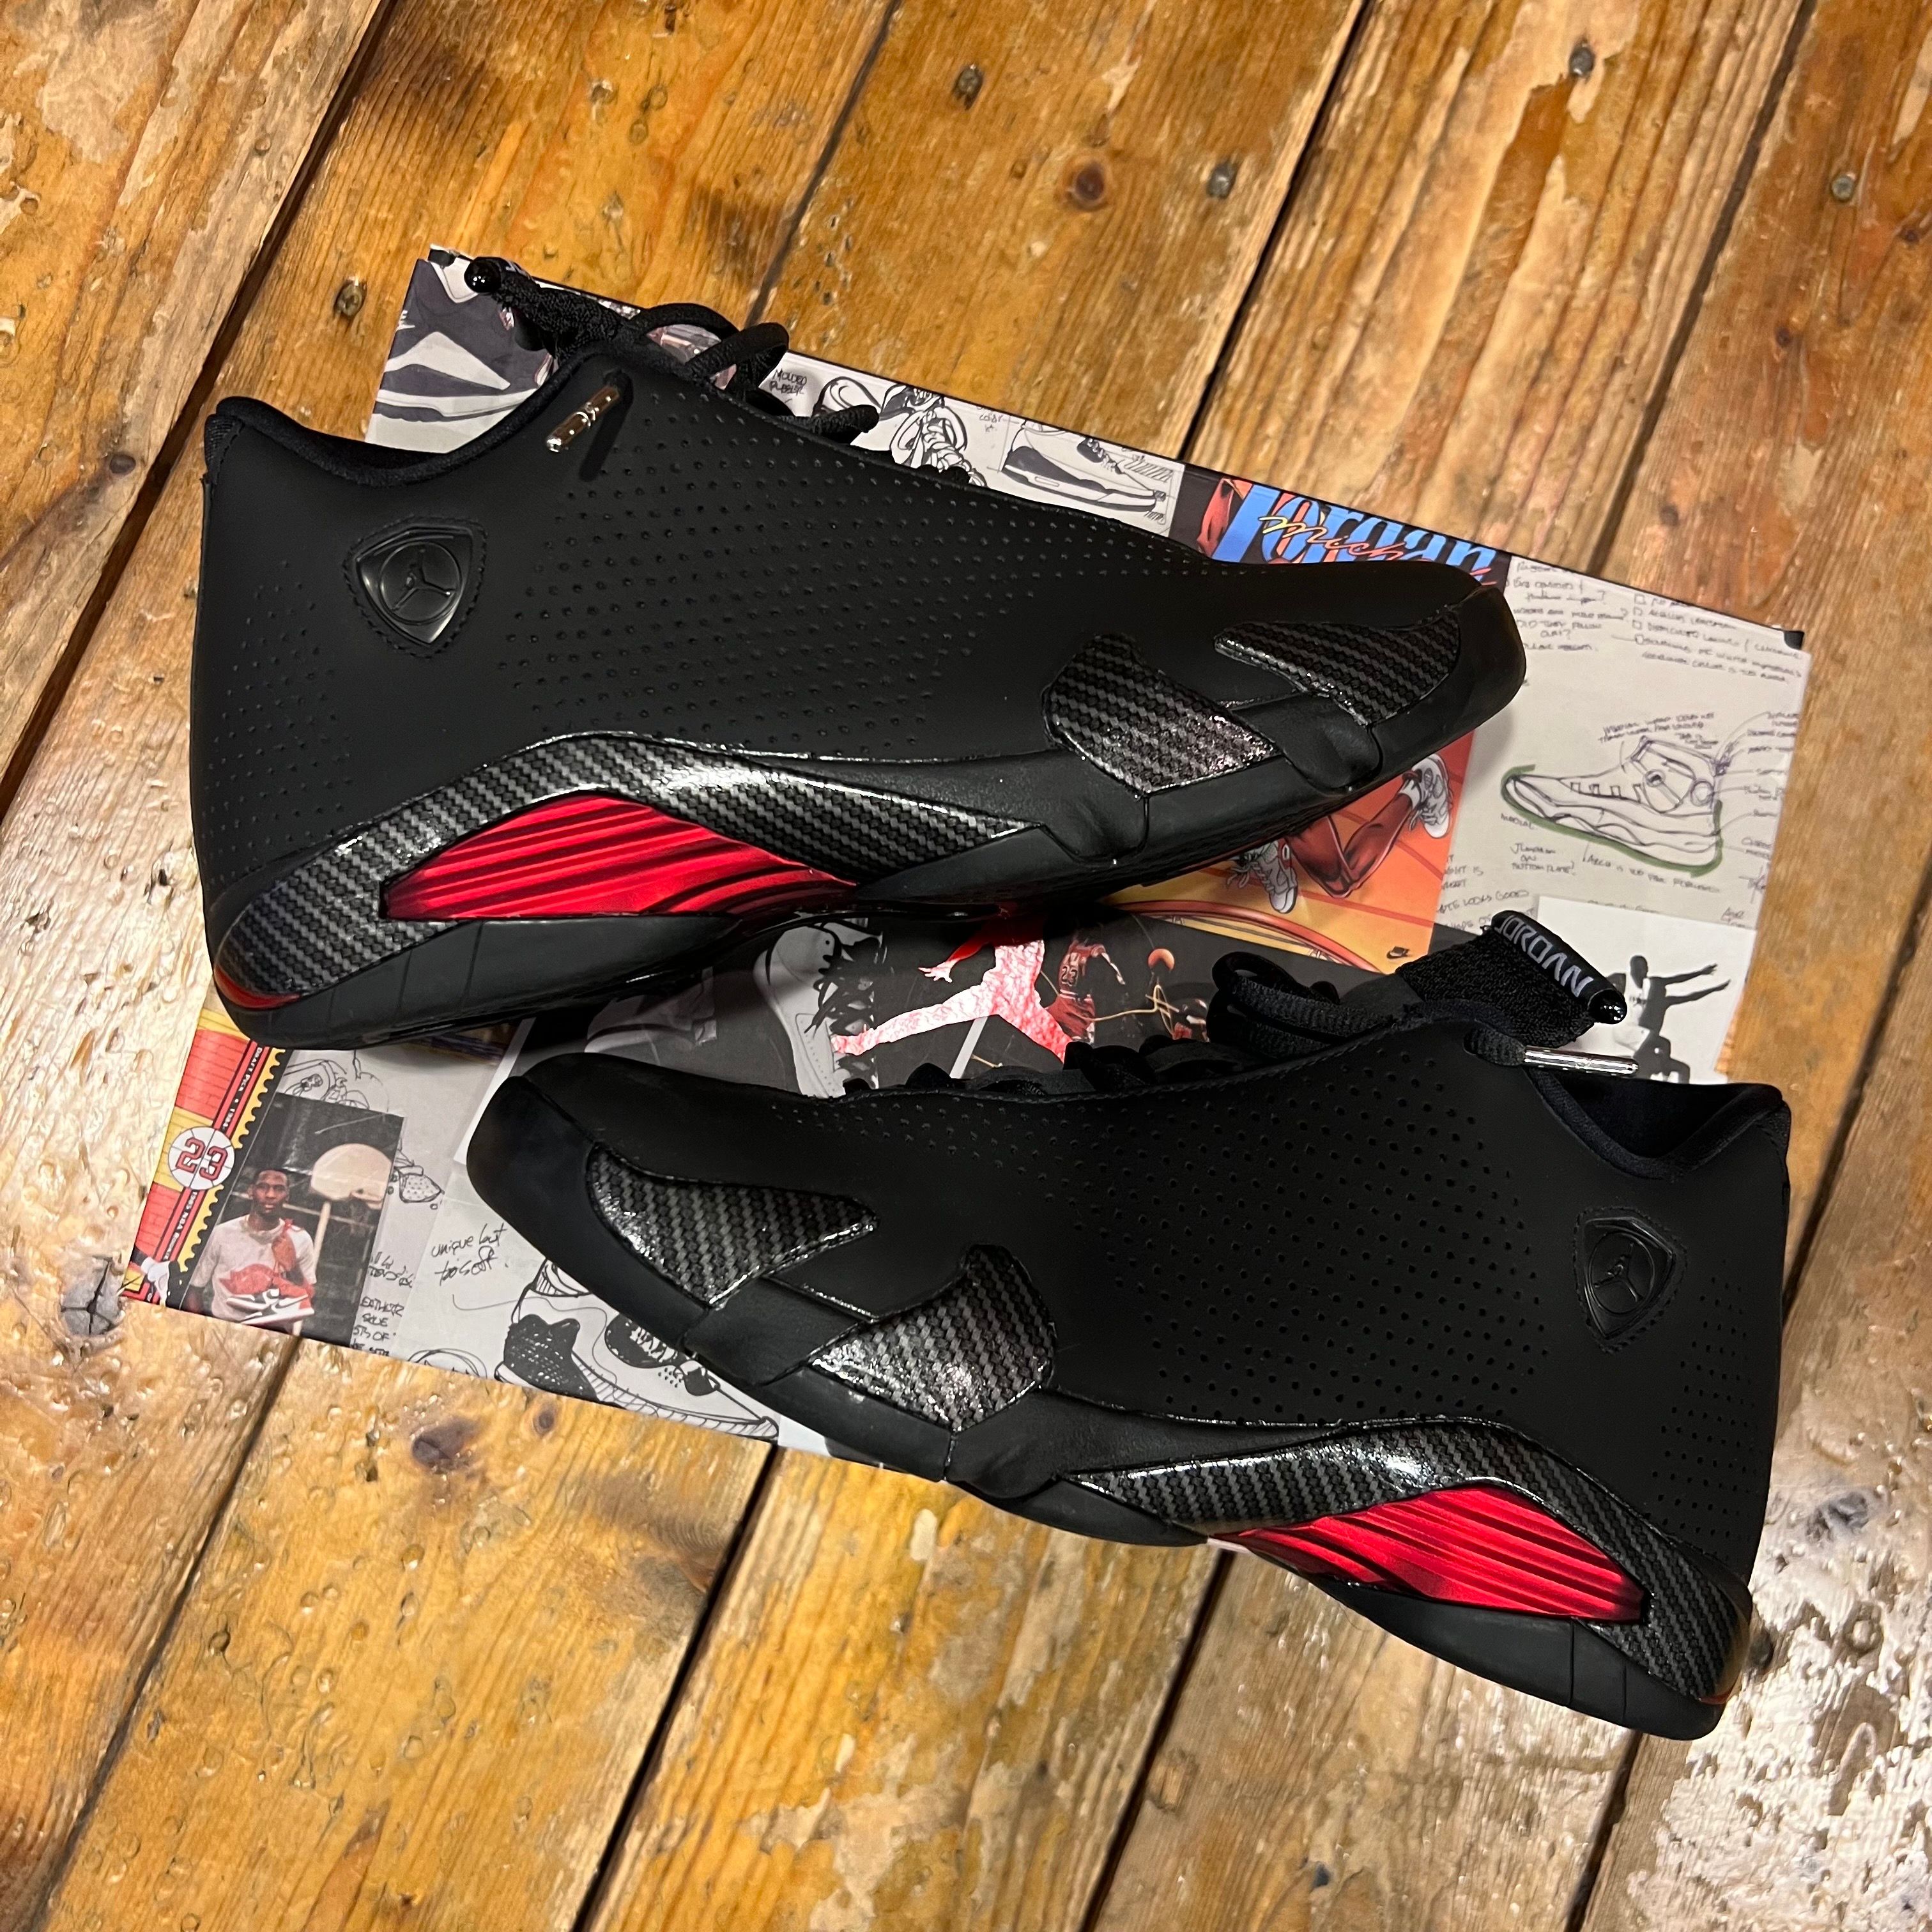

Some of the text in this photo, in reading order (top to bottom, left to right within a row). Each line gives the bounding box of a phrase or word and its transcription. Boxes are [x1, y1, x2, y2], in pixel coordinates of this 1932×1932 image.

[1494, 915, 1594, 997] JORDAN
[1061, 965, 1078, 986] 23
[175, 1137, 228, 1181] 23
[177, 1211, 188, 1230] NBA
[431, 1236, 473, 1257] unique
